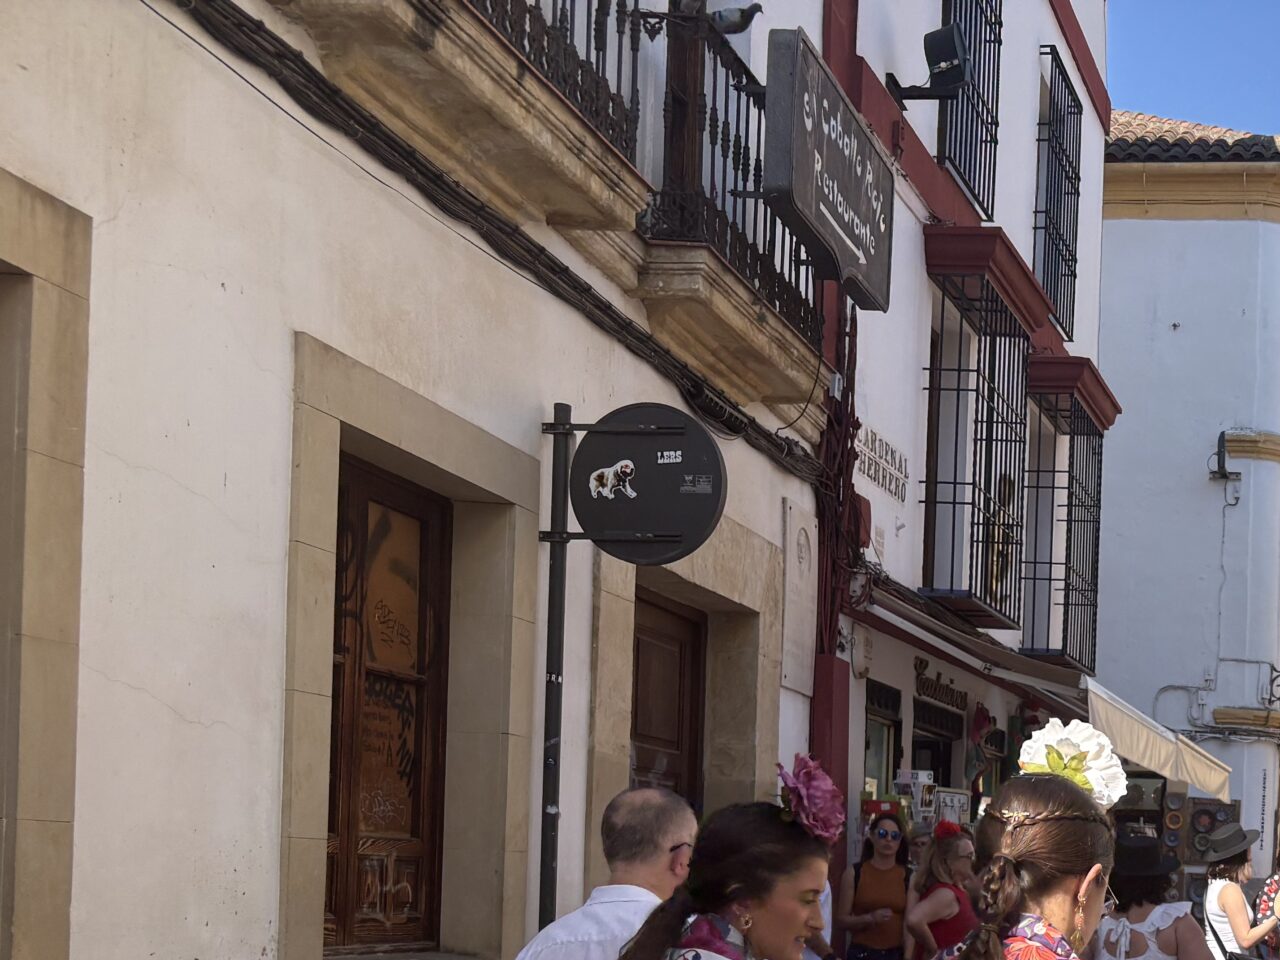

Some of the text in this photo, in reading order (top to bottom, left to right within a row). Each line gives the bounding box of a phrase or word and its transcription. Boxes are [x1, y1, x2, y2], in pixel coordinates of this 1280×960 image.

[803, 91, 887, 233] El Caballo Rojo
[813, 148, 876, 255] Restaurante
[656, 450, 683, 465] LERS
[855, 426, 910, 479] CARDENAL
[857, 451, 908, 503] HERRERO
